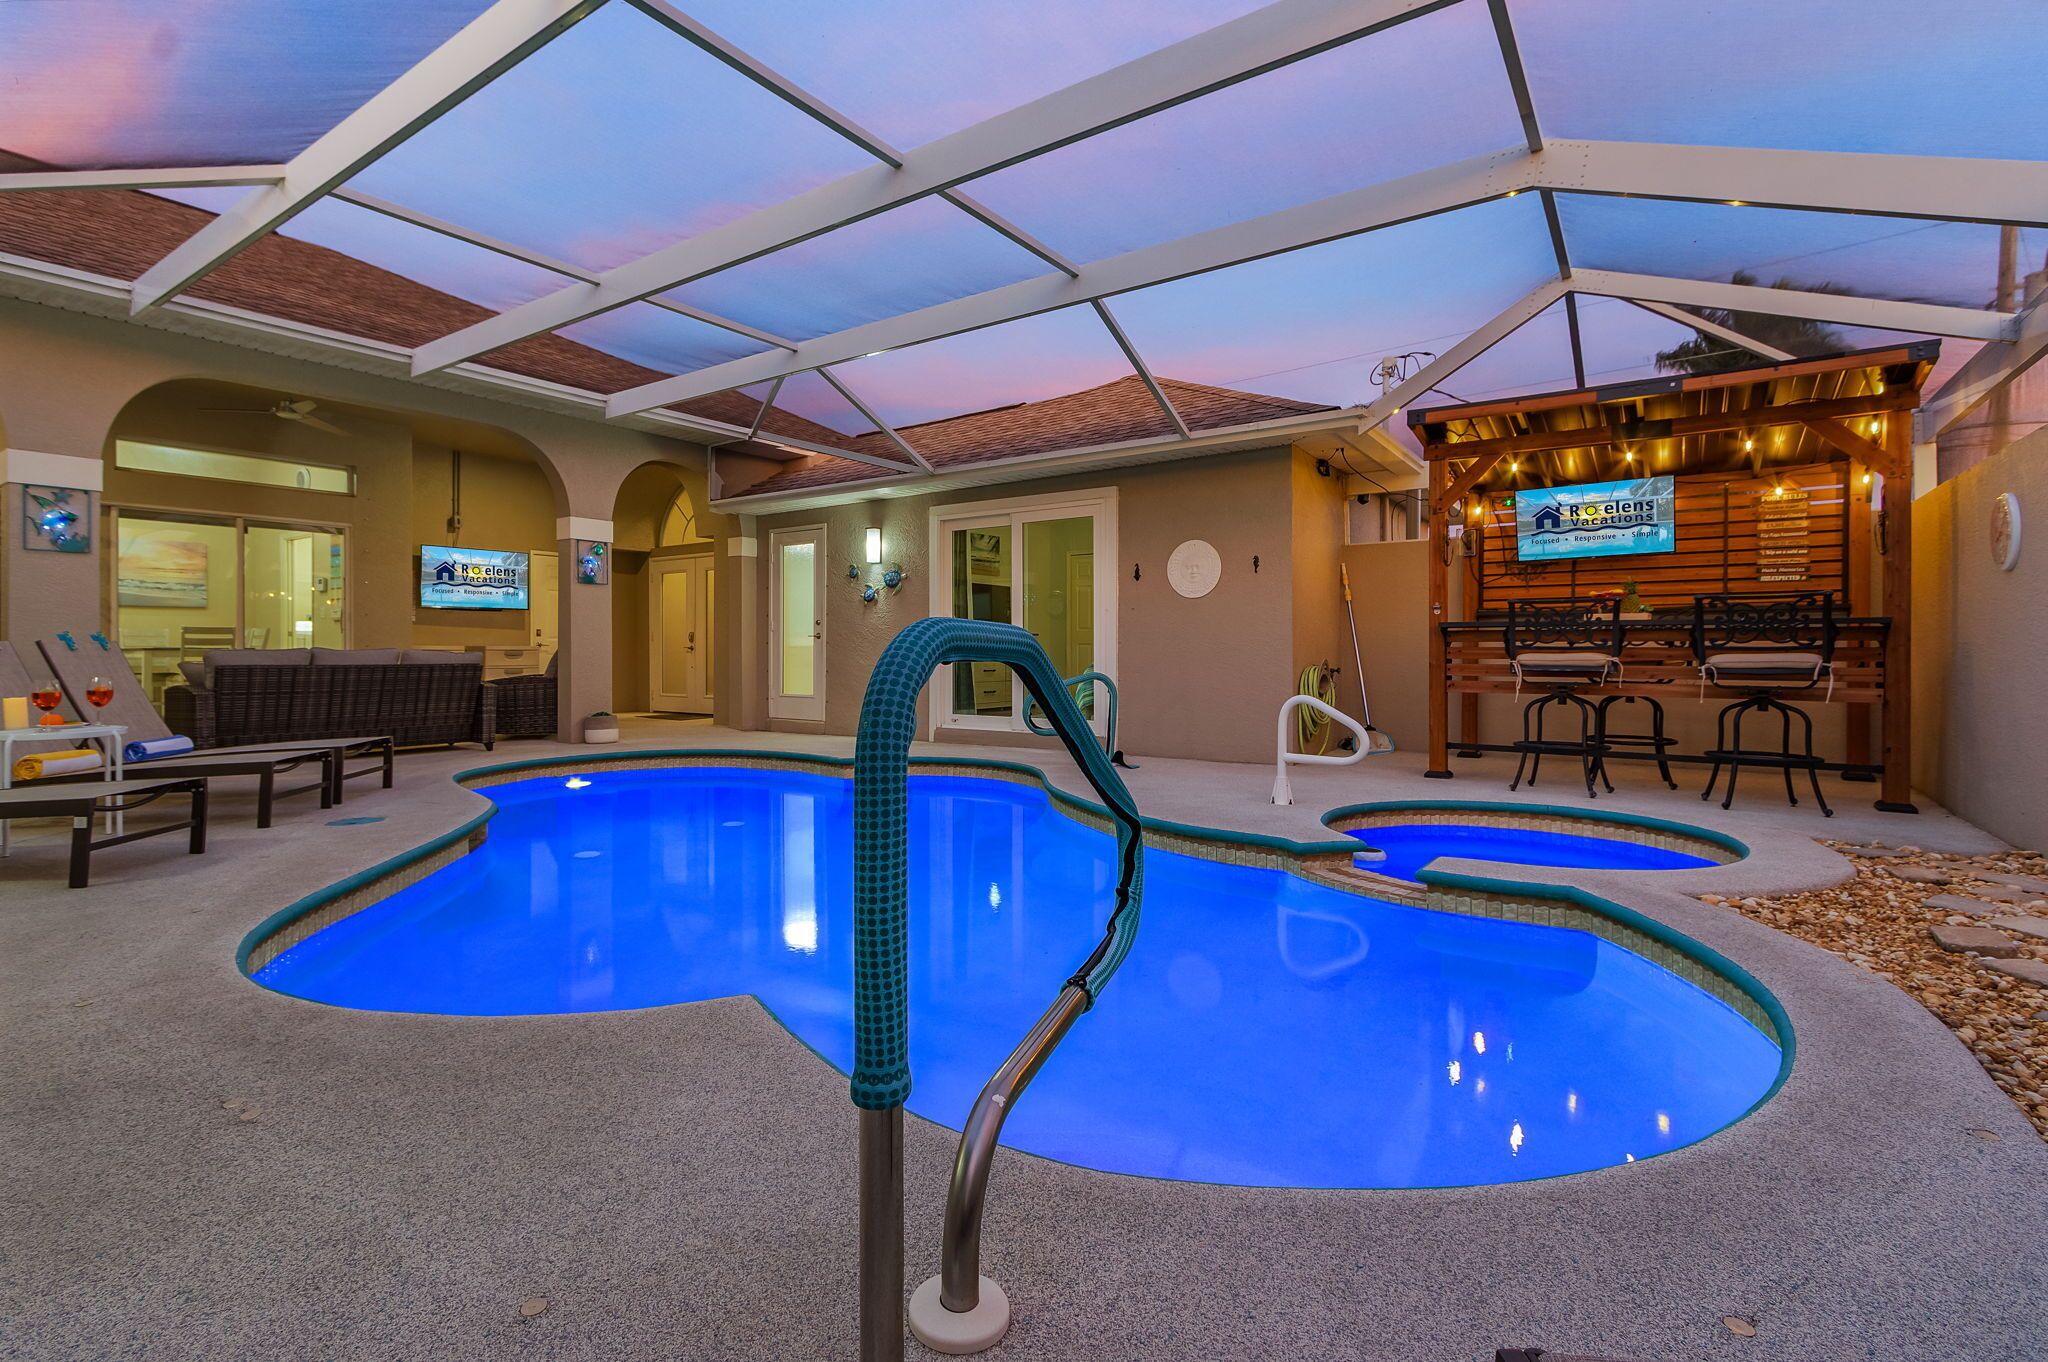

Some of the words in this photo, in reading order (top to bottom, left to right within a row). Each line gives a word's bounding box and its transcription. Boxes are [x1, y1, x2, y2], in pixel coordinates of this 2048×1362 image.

[1570, 514, 1653, 527] Vacations
[1531, 537, 1560, 545] Focused
[1574, 533, 1616, 543] Responsive
[1631, 530, 1658, 539] Simple
[462, 575, 516, 585] Vacations
[464, 589, 492, 597] Responsive
[502, 589, 519, 597] Simple
